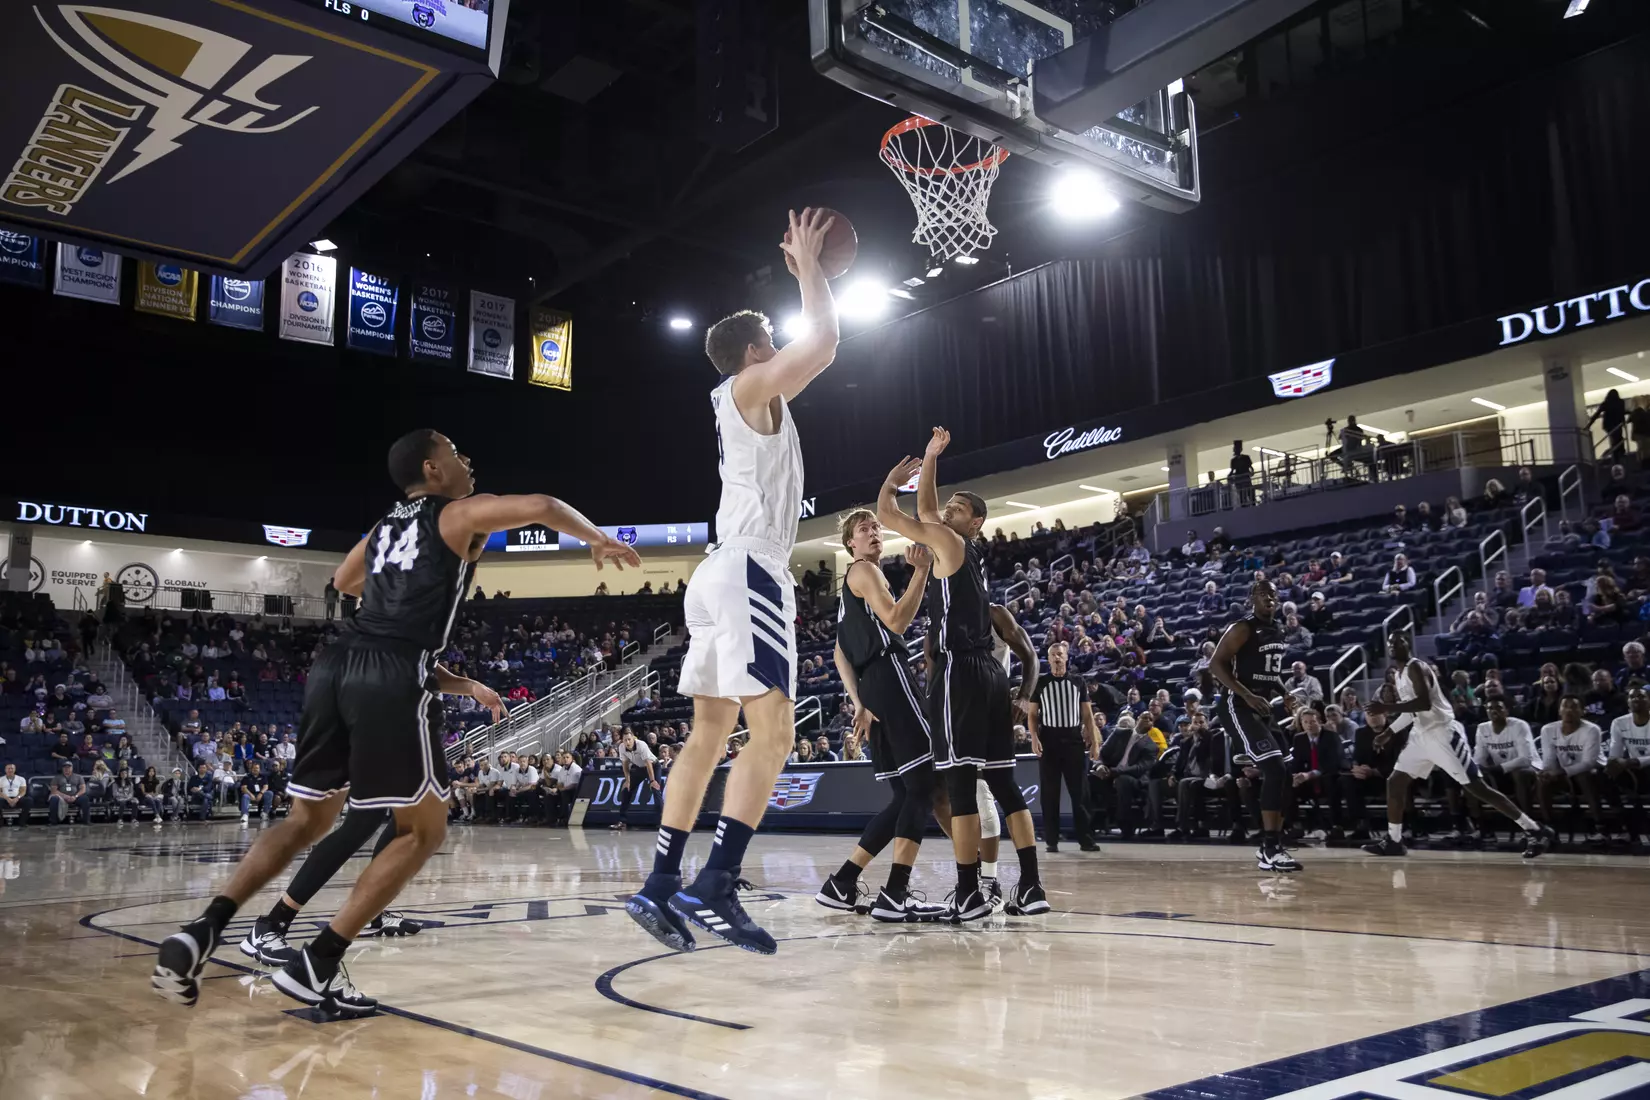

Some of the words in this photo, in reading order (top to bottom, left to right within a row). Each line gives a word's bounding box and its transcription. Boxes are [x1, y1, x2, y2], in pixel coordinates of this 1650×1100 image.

[325, 0, 351, 15] FLS
[1, 84, 143, 215] LANCERS
[294, 259, 323, 272] 2016
[61, 265, 84, 276] WEST
[85, 269, 117, 282] REGION
[158, 271, 181, 280] NCAA
[360, 272, 389, 286] 2017
[62, 275, 114, 289] CHAMPIONS
[285, 278, 332, 292] BASKETBALL
[355, 282, 392, 296] WOMEN'S
[143, 285, 182, 297] DIVISION
[351, 289, 398, 304] BASKETBALL
[422, 286, 448, 299] 2017
[144, 292, 188, 305] NATIONAL
[140, 300, 178, 312] RUNNER
[210, 299, 261, 314] CHAMPIONS
[480, 300, 505, 312] 2017
[290, 313, 320, 323] DIVISION
[283, 320, 331, 332] TOURNAMENT
[350, 327, 395, 341] CHAMPIONS
[414, 346, 452, 359] CHAMPIONS
[1043, 426, 1122, 460] Cadillac
[17, 501, 148, 532] DUTTON
[519, 530, 547, 544] 17:14
[372, 519, 420, 573] 14
[51, 570, 98, 580] EQUIPPED
[51, 577, 64, 585] TO
[66, 578, 96, 587] SERVE
[164, 578, 207, 588] GLOBALLY
[1259, 643, 1284, 652] CENTR
[1265, 653, 1282, 673] 13
